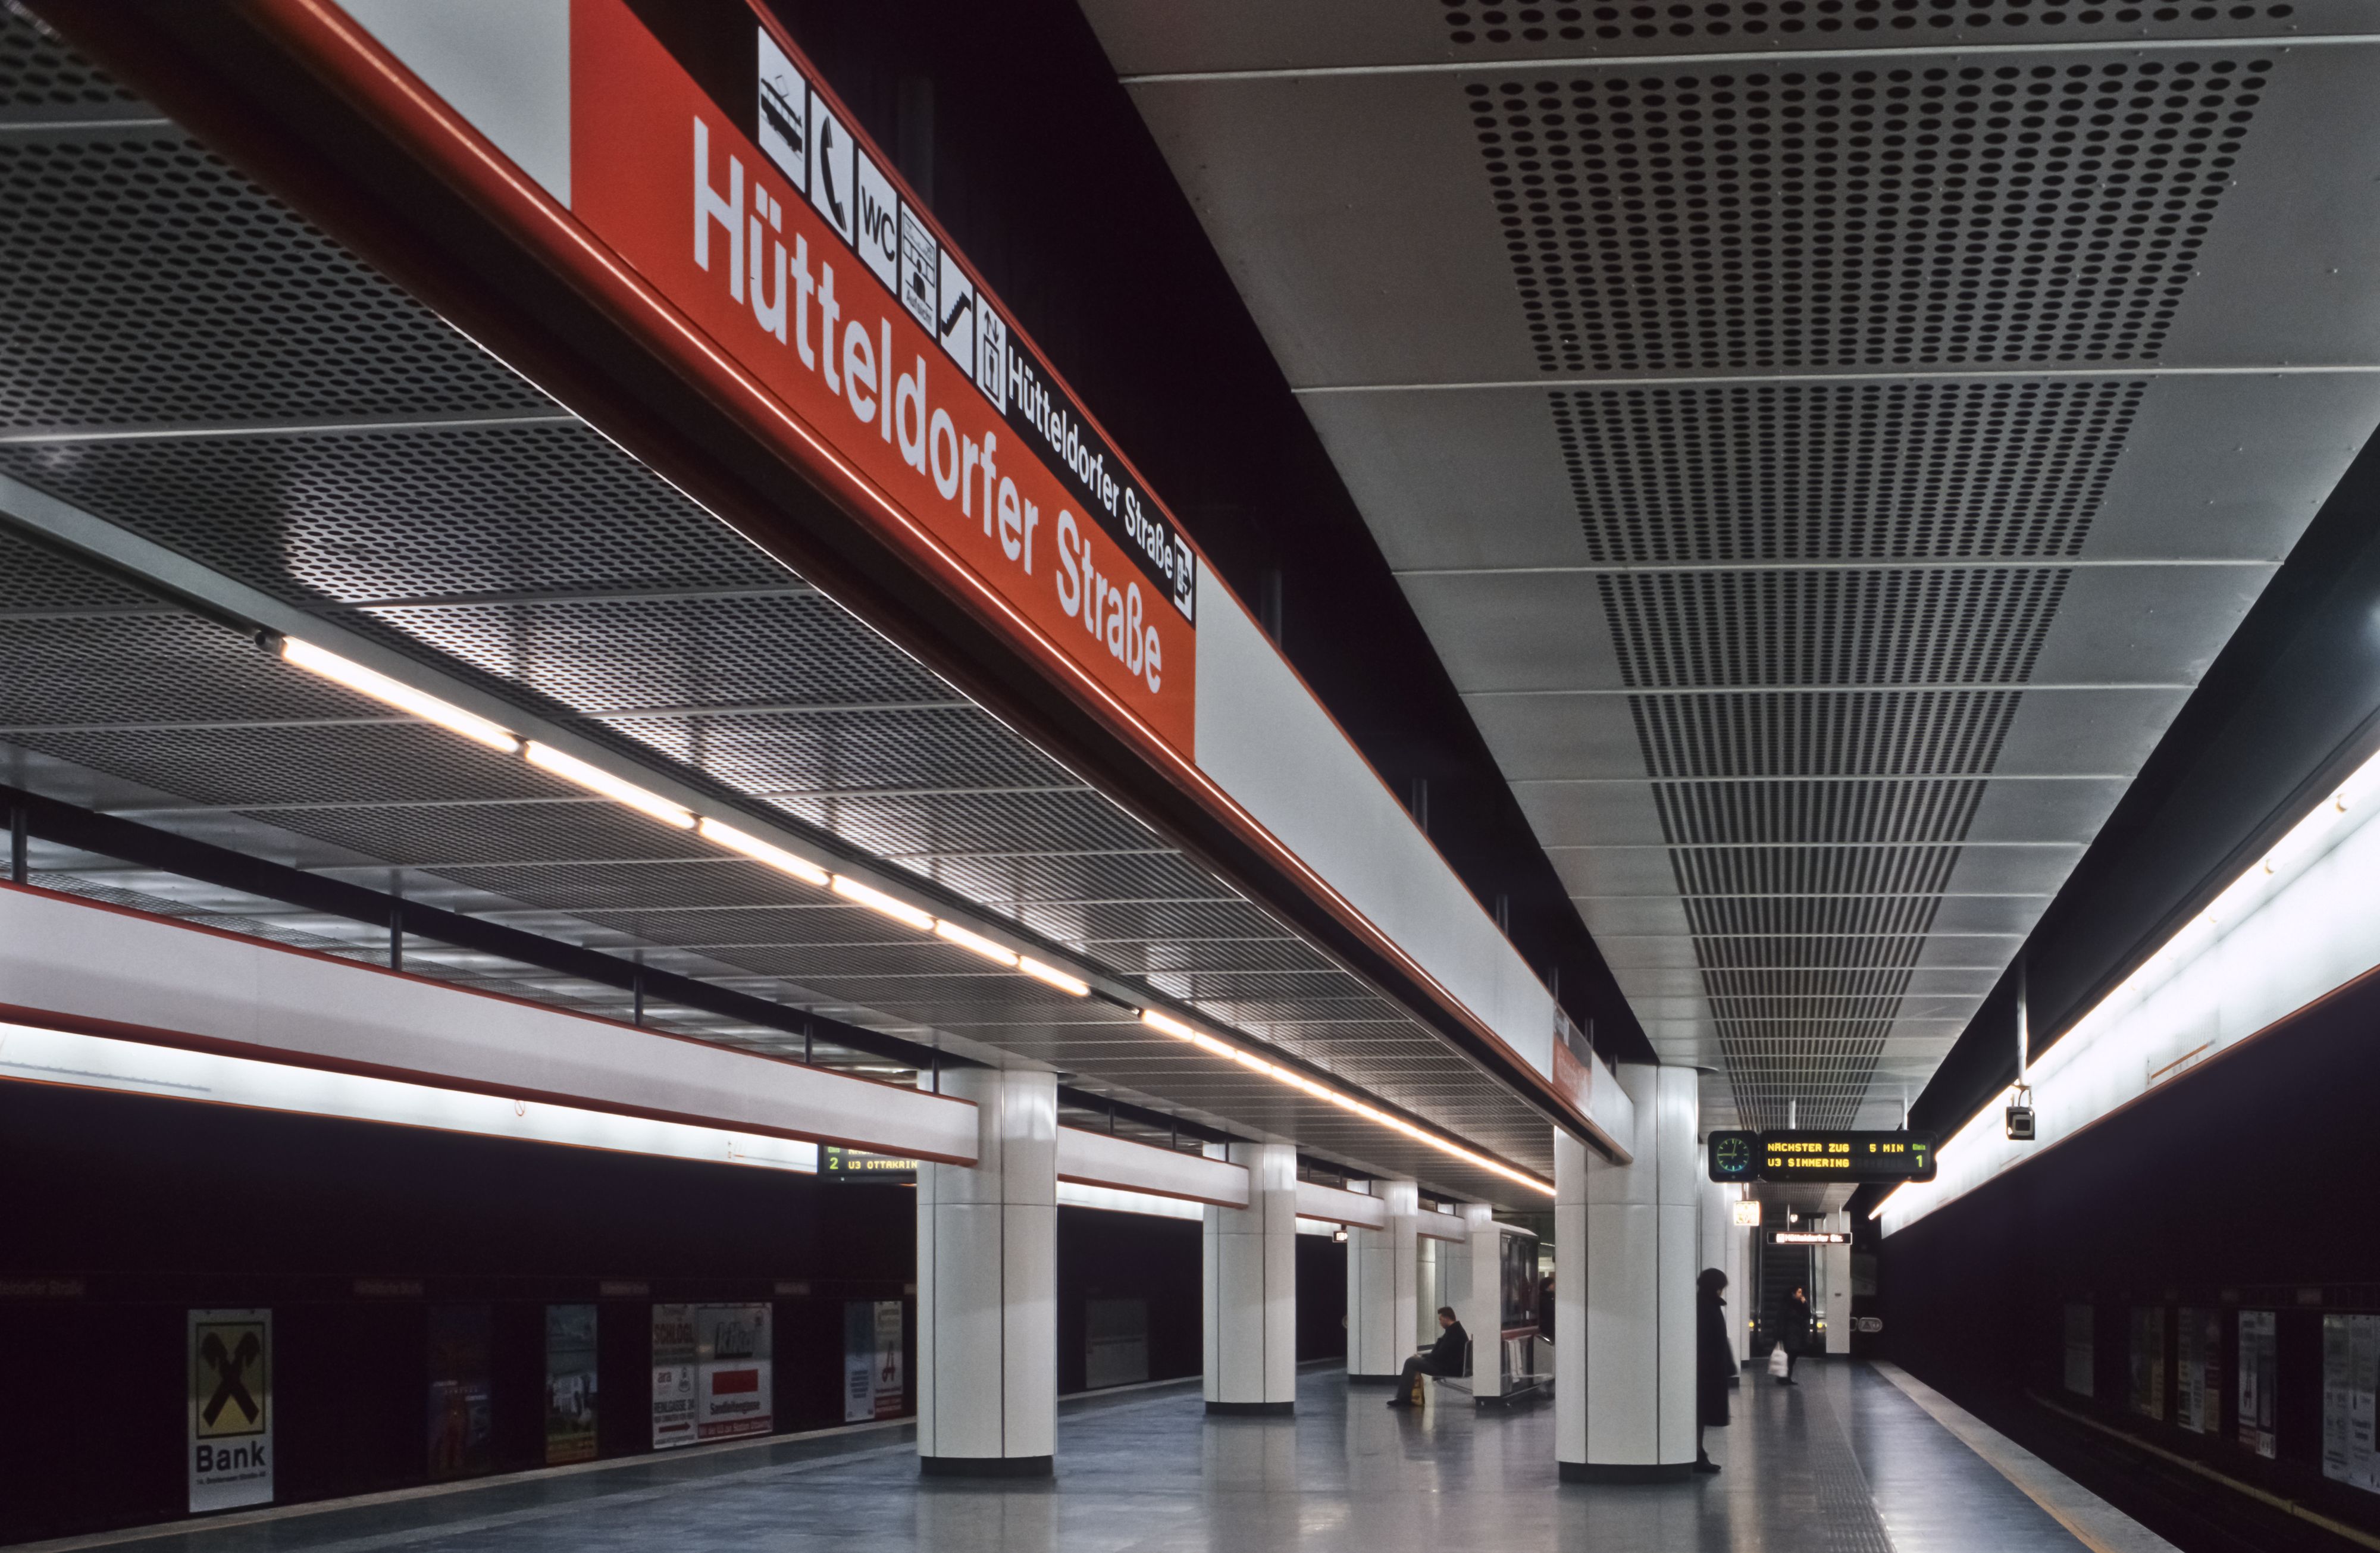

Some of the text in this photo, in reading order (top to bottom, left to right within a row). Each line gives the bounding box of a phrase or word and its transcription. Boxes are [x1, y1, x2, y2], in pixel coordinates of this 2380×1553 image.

[862, 184, 895, 262] WC
[694, 115, 1161, 694] Hütteldorfer Straße
[1009, 345, 1173, 579] Hütteldorfer Straße
[1767, 1142, 1904, 1153] NÄCHSTER ZUG 5 MIN
[829, 1157, 838, 1170] 2
[848, 1160, 861, 1170] U3
[1767, 1157, 1850, 1167] U3 SIMMERING
[1916, 1155, 1922, 1167] 1
[196, 1441, 266, 1473] Bank
